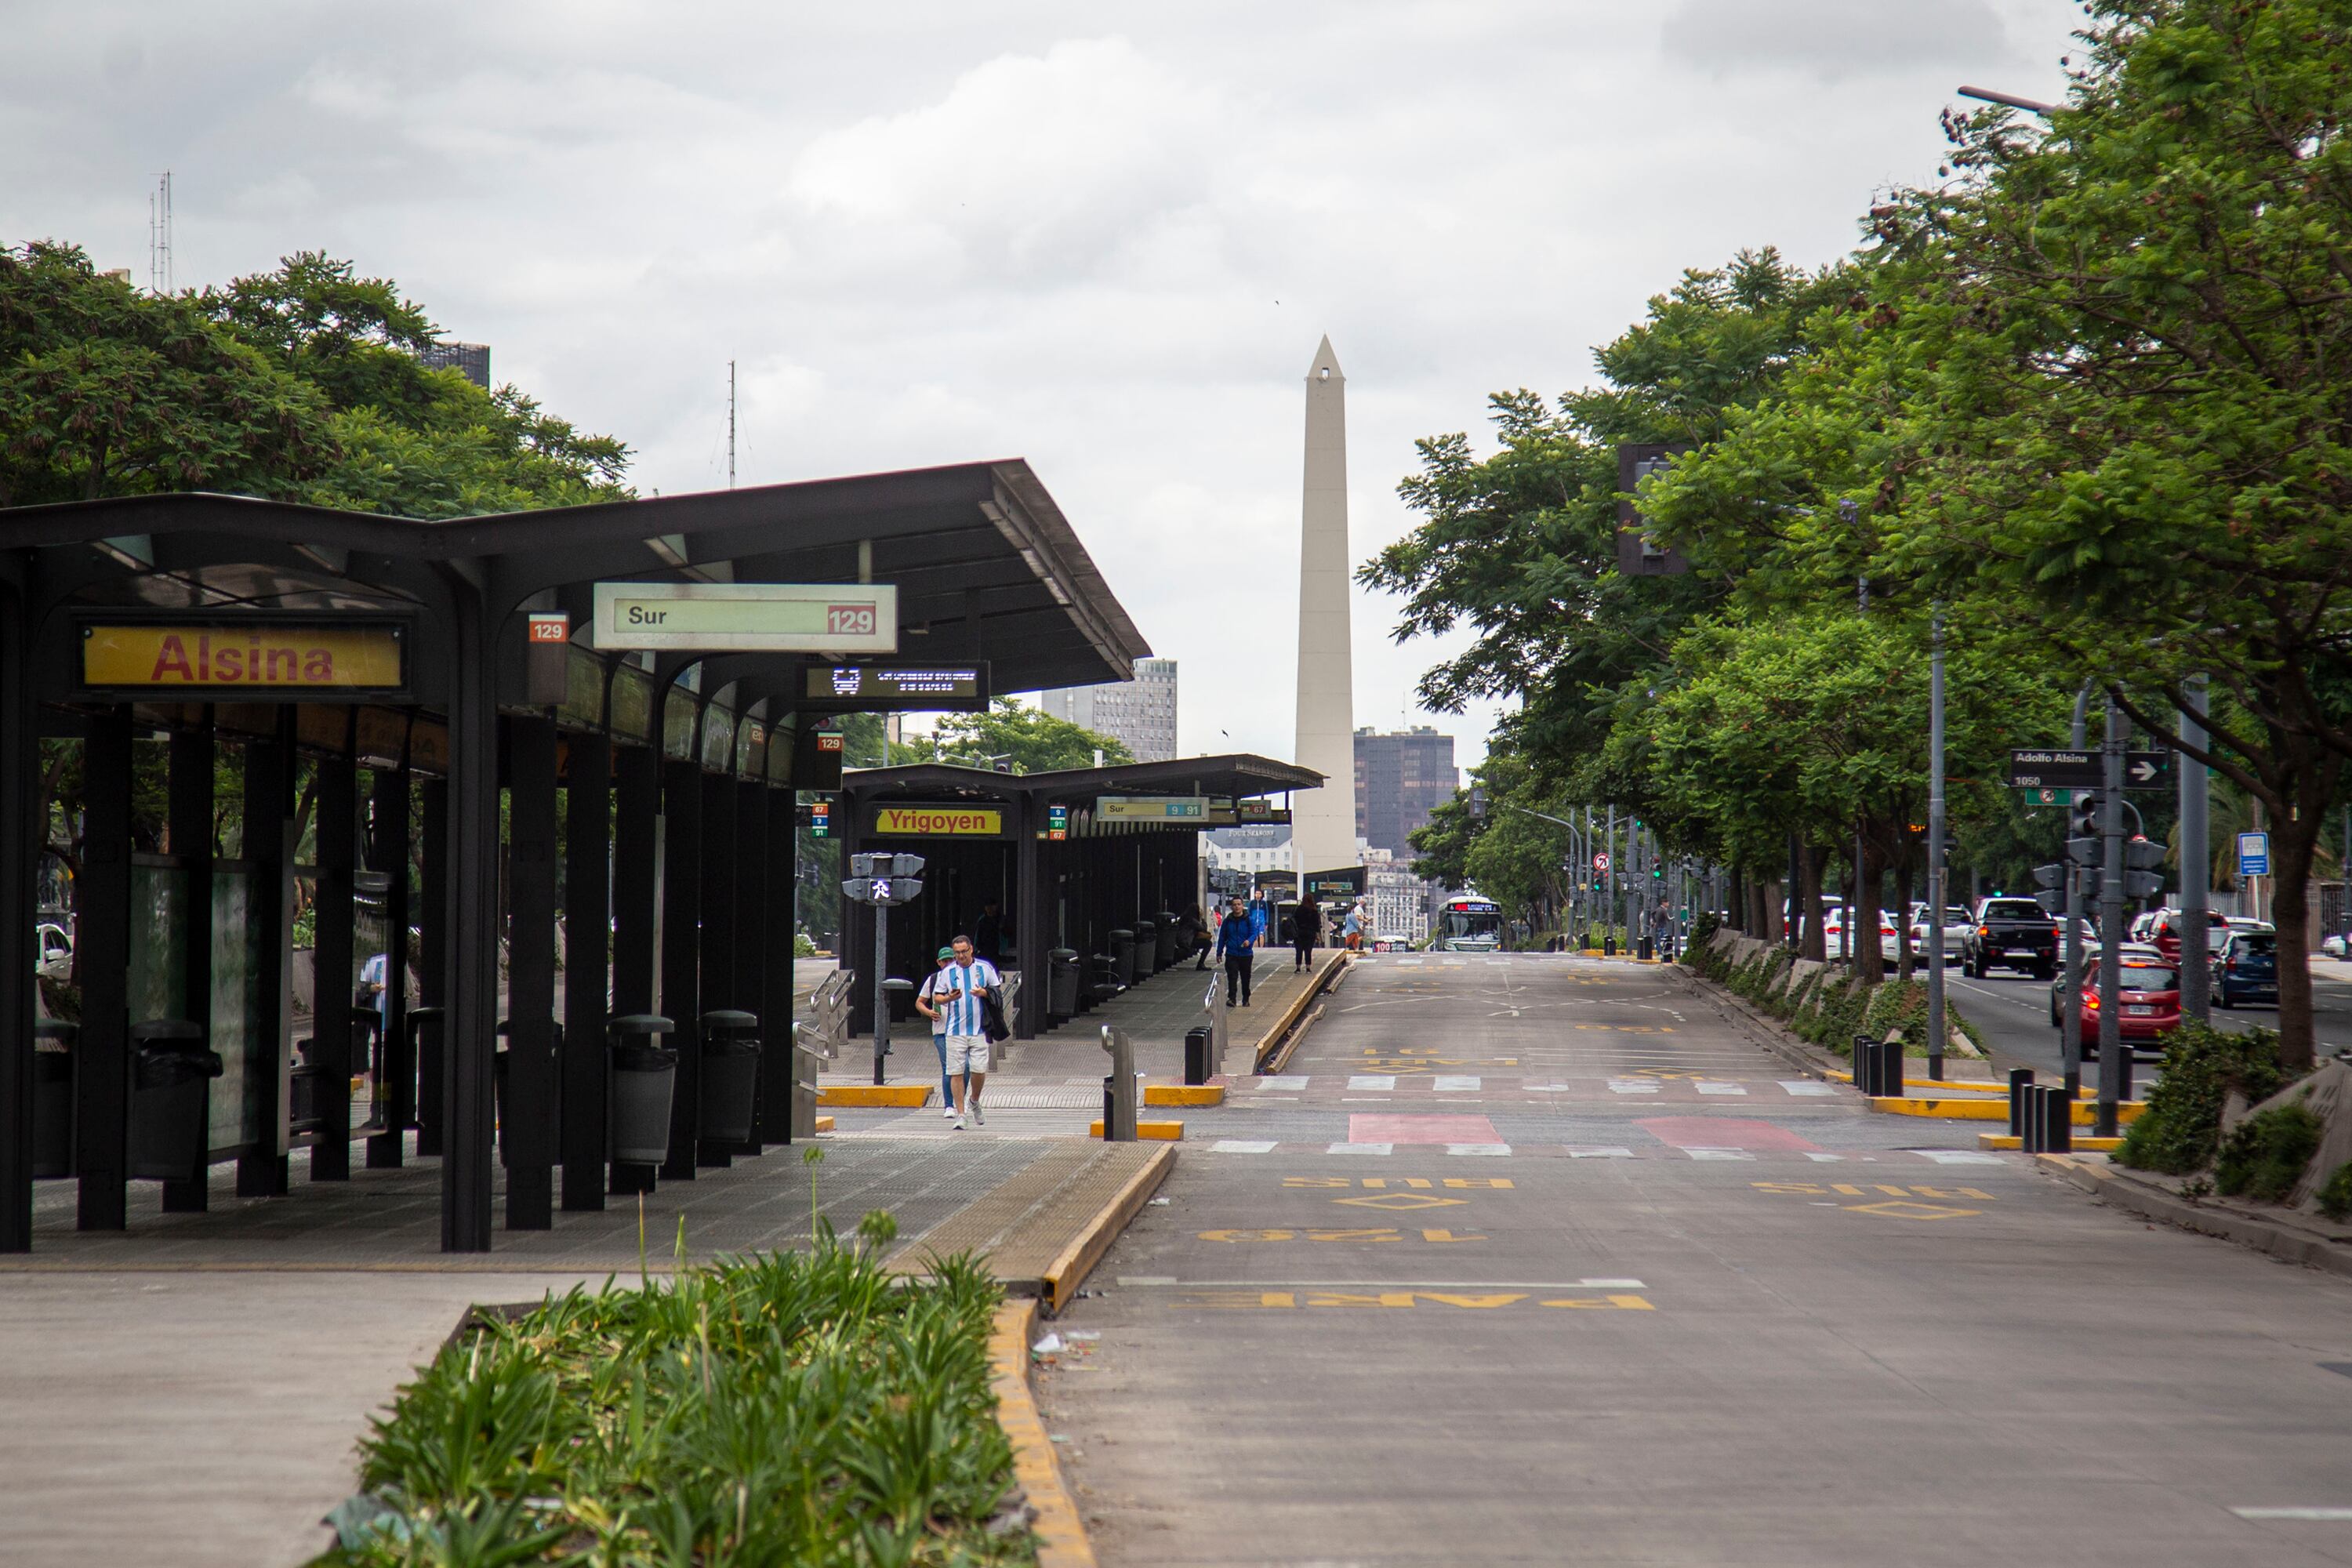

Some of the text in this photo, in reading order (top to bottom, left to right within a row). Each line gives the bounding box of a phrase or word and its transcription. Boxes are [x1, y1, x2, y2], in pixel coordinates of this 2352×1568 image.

[628, 606, 875, 633] Sur 129
[534, 624, 563, 640] 129
[151, 633, 334, 681] Alsina
[822, 739, 840, 749] 129
[2016, 752, 2088, 765] Adolfo Alsina
[2015, 776, 2041, 787] 1050
[1186, 806, 1199, 815] 91
[888, 809, 986, 834] Yrigoyen
[1377, 943, 1390, 953] 100
[1282, 1178, 1515, 1189] BUS
[1197, 1229, 1488, 1243] 129
[1169, 1290, 1657, 1311] PARE
